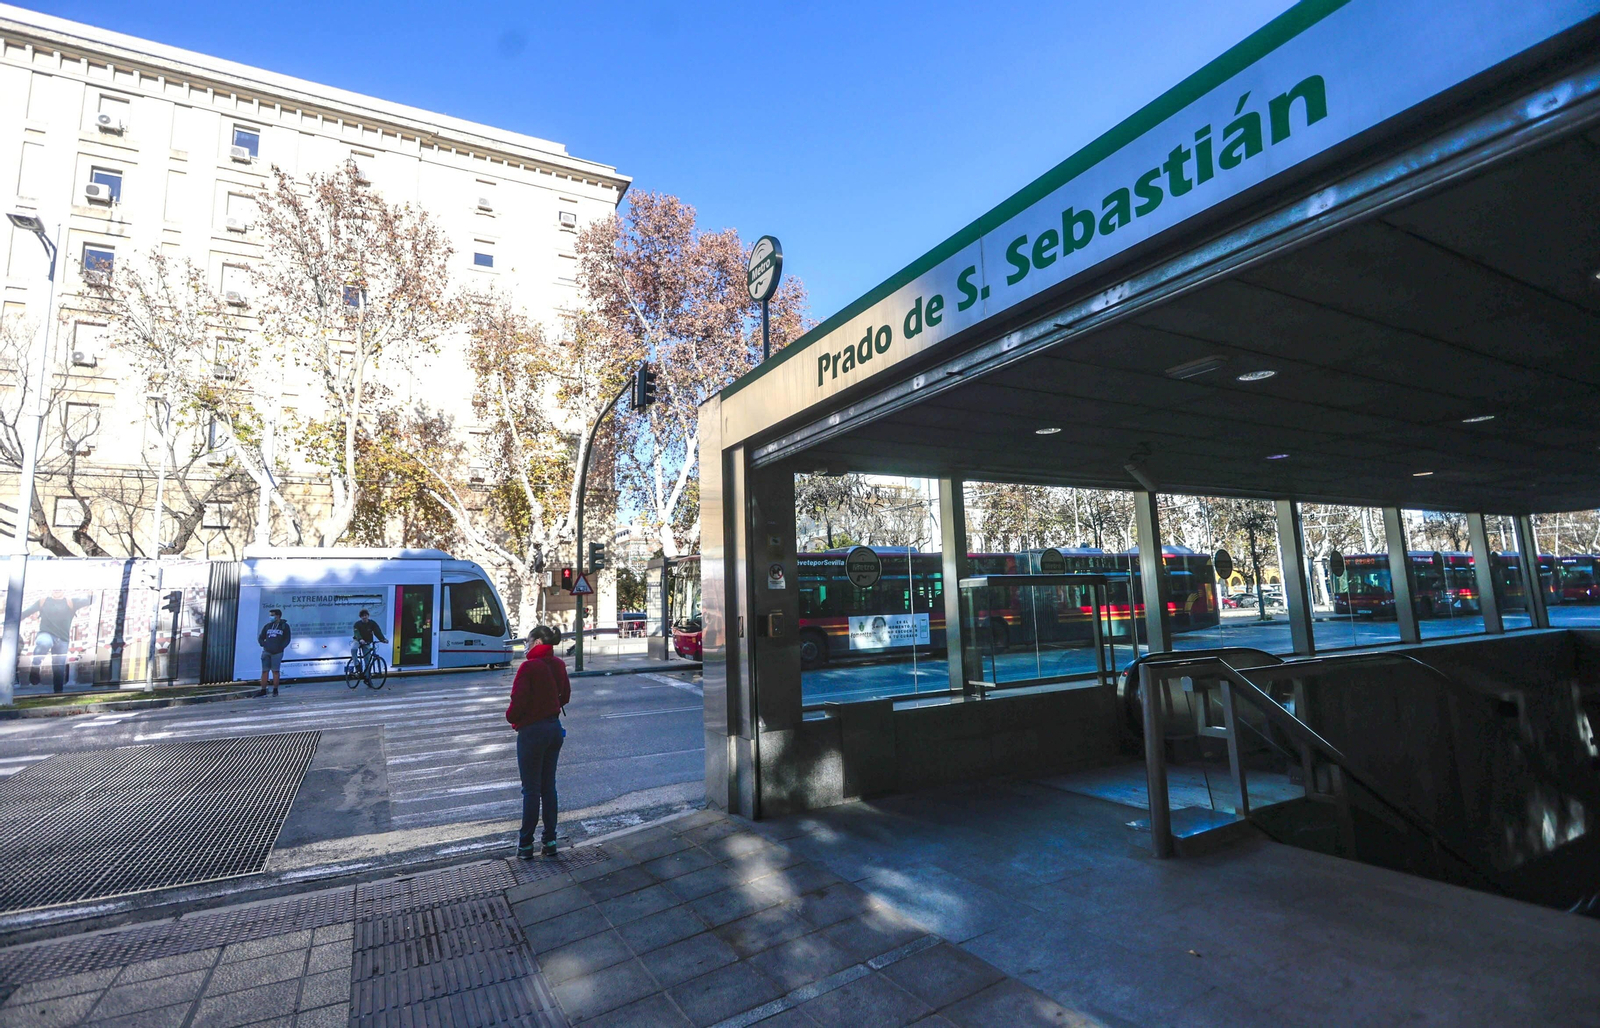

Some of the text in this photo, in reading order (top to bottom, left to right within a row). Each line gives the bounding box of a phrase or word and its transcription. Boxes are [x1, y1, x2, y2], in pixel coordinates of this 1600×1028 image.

[817, 74, 1328, 387] Prado de S. Sebastián
[751, 259, 771, 282] Metro
[852, 563, 875, 571] Metro
